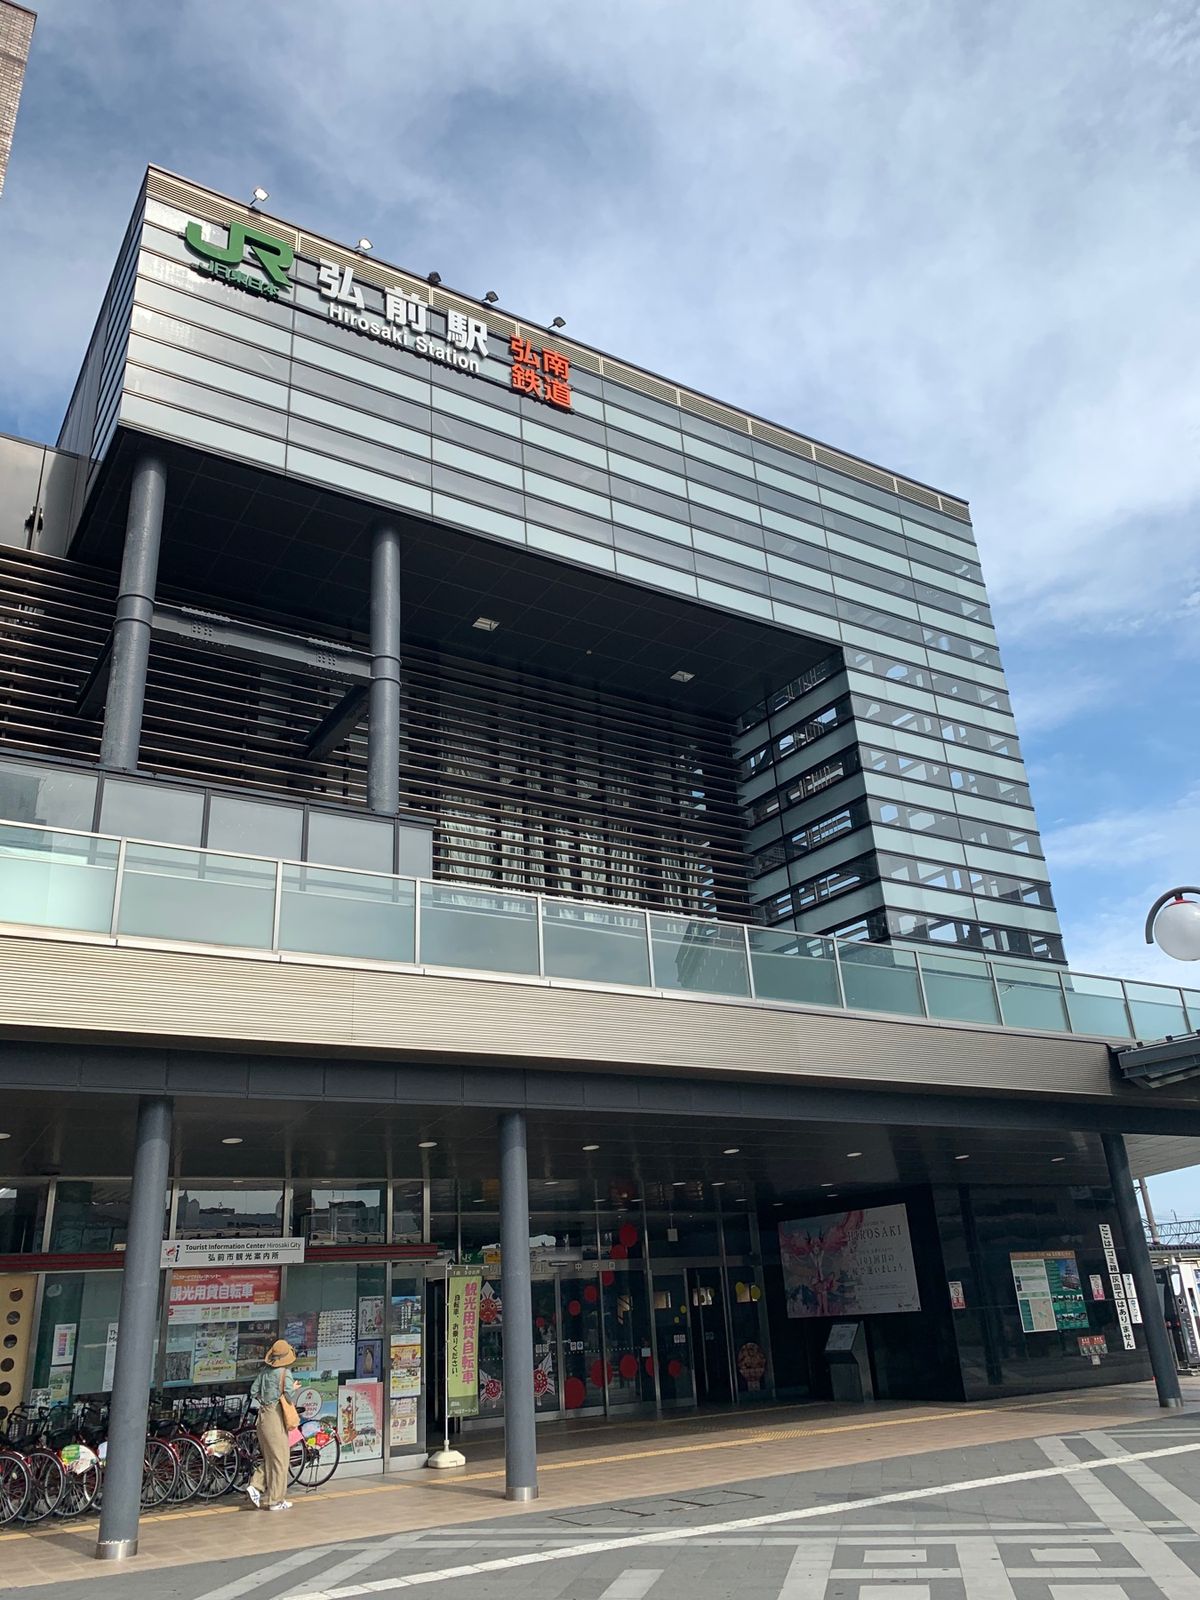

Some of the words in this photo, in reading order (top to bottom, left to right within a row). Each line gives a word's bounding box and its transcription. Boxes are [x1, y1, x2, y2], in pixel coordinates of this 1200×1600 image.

[186, 220, 293, 288] JR
[199, 260, 279, 297] JR東日本
[319, 257, 489, 357] 弘前駅
[329, 302, 409, 346] Hirosaki
[415, 336, 480, 374] Station
[510, 334, 571, 382] 弘南
[511, 363, 573, 409] 鉄道
[185, 1243, 208, 1251] Tourist
[208, 1242, 246, 1250] Information
[266, 1241, 290, 1249] Hirosaki
[290, 1241, 302, 1249] City
[847, 1224, 902, 1242] HIROSAKI
[207, 1251, 279, 1262] 弘前市観光案内所
[170, 1283, 254, 1301] 観光用貸自転車
[461, 1281, 478, 1385] 観光用貸自転車
